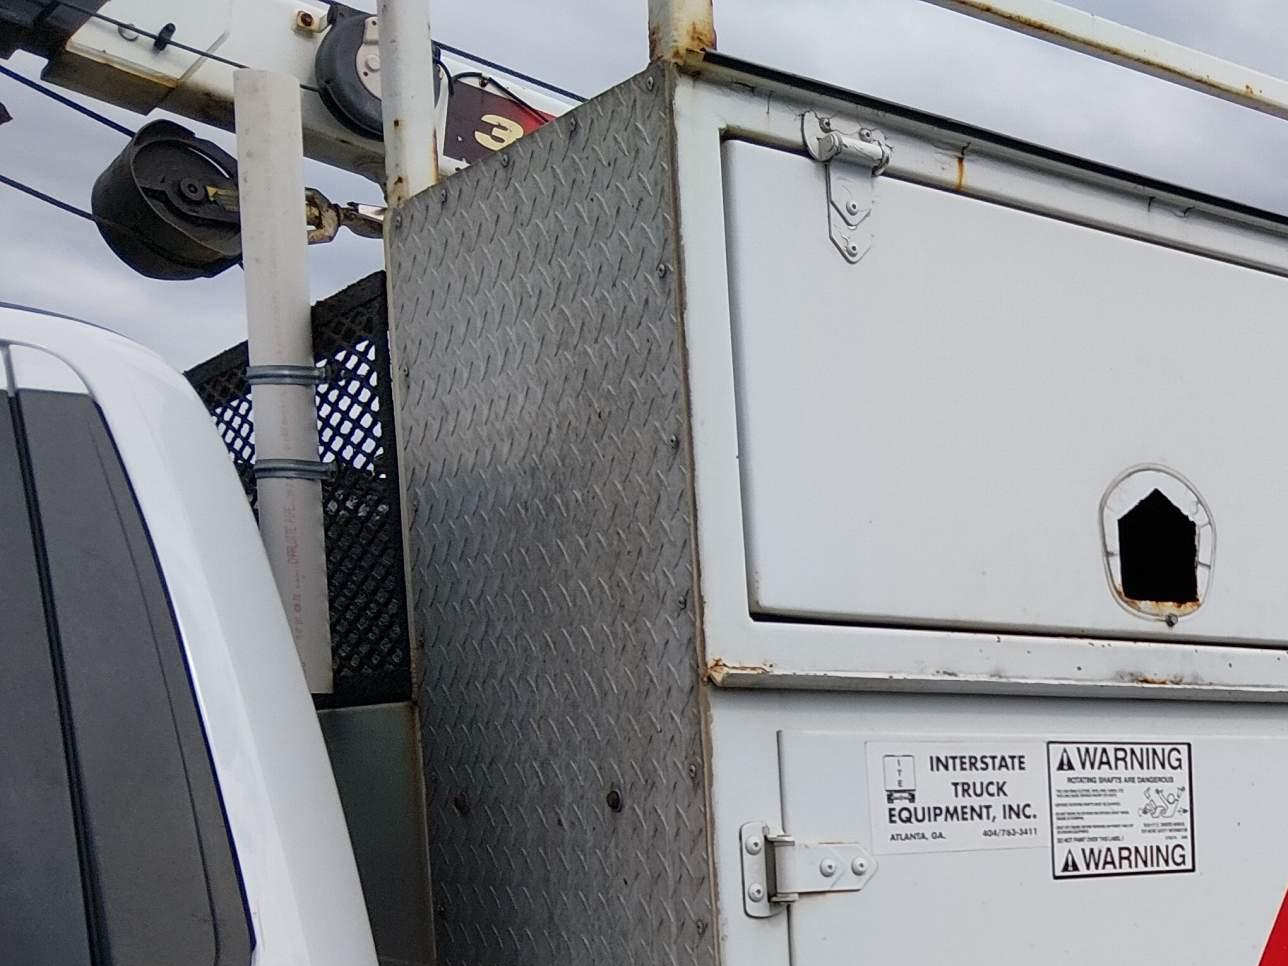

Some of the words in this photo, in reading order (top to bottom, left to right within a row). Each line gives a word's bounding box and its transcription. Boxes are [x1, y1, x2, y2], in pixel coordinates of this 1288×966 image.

[474, 114, 524, 151] 3
[929, 755, 1026, 772] INTERSTATE
[1076, 747, 1183, 770] WARNING
[951, 781, 1008, 798] TRUCK
[888, 804, 996, 824] EQUIPMENT,
[1002, 803, 1037, 820] INC.
[890, 832, 928, 841] ATLANTA,
[1081, 844, 1186, 870] WARNING
